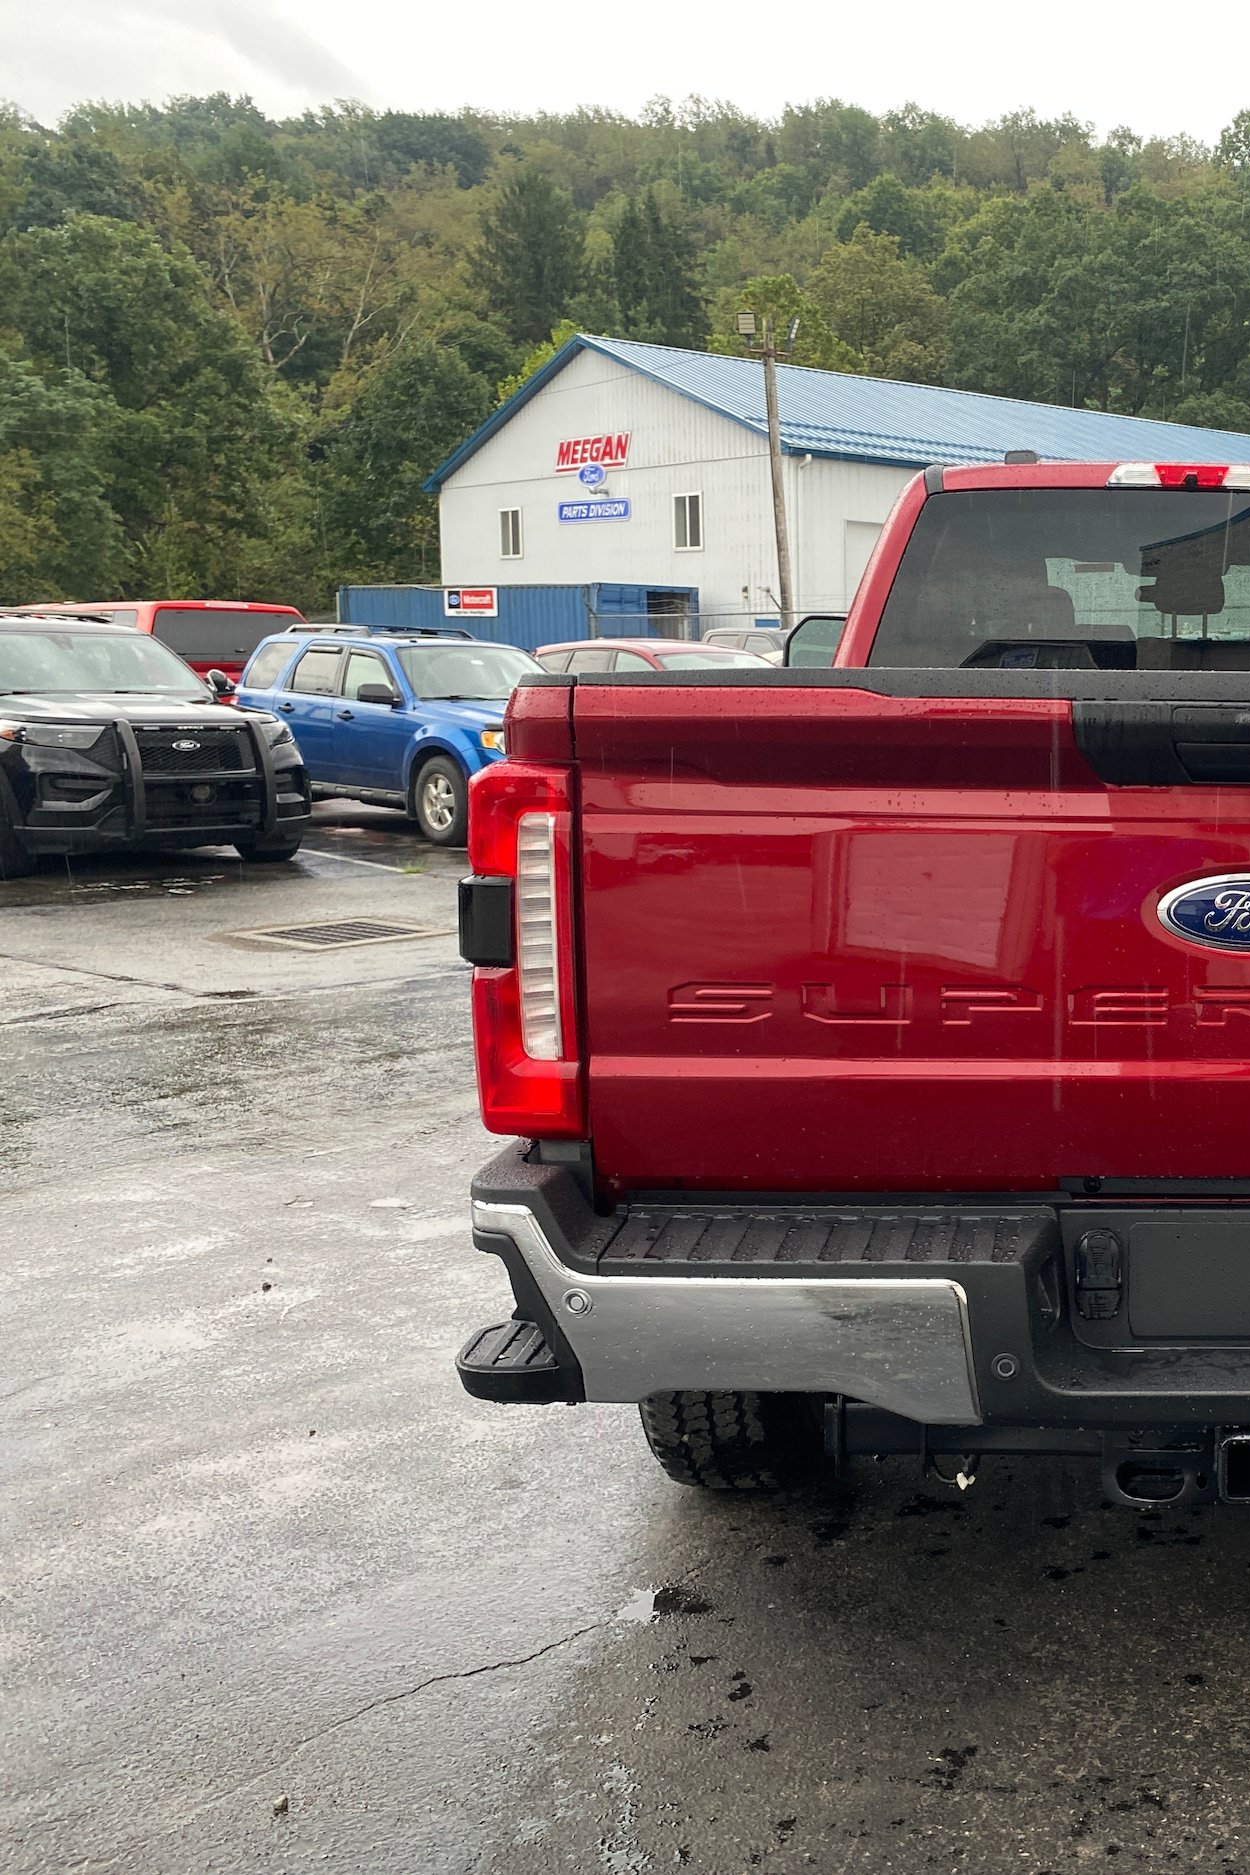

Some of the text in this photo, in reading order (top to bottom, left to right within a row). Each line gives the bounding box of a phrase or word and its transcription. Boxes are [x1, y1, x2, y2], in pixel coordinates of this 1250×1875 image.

[557, 434, 629, 466] MEEGAN
[582, 467, 600, 483] Ford
[562, 502, 626, 518] PARTS DIVISION
